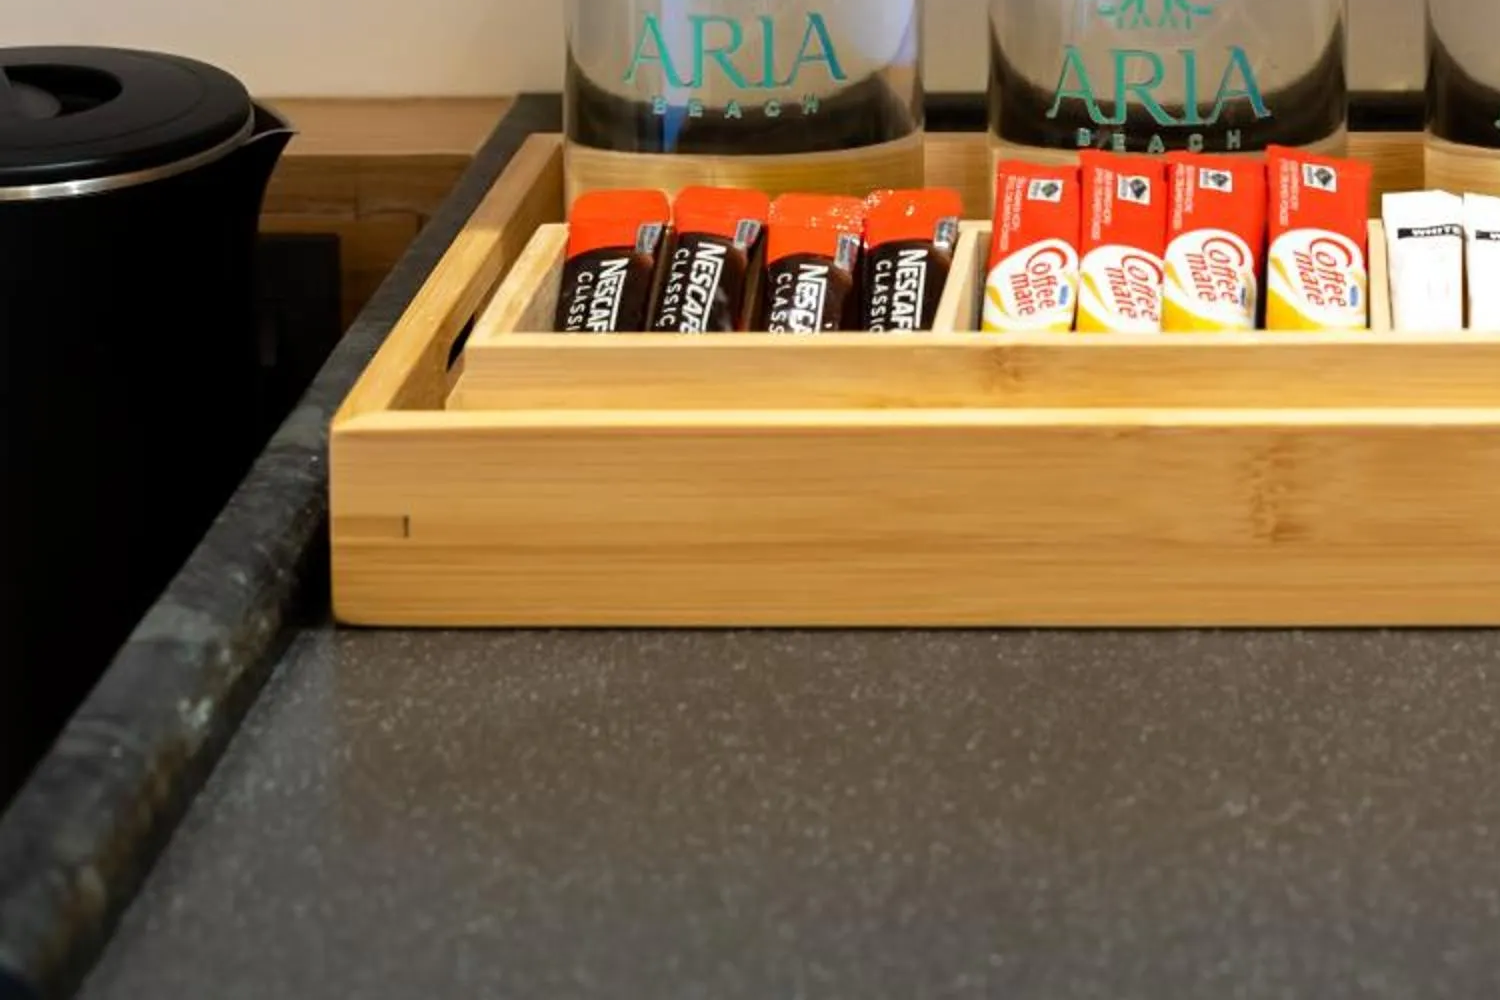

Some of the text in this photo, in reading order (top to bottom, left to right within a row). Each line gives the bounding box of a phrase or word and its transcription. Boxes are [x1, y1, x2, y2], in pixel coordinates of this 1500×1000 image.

[622, 11, 847, 89] ARIA
[652, 95, 820, 118] BEACH
[1046, 45, 1272, 126] ARIA
[1076, 128, 1241, 152] BEACH
[566, 271, 593, 331] CLASSI
[586, 258, 629, 333] NESCAF
[660, 248, 690, 326] CLASSIC
[768, 272, 793, 333] CLASS
[890, 249, 928, 332] NESCAF
[1026, 247, 1068, 309] Coffee
[1202, 237, 1244, 303] Coffee
[1309, 237, 1353, 307] Coffee
